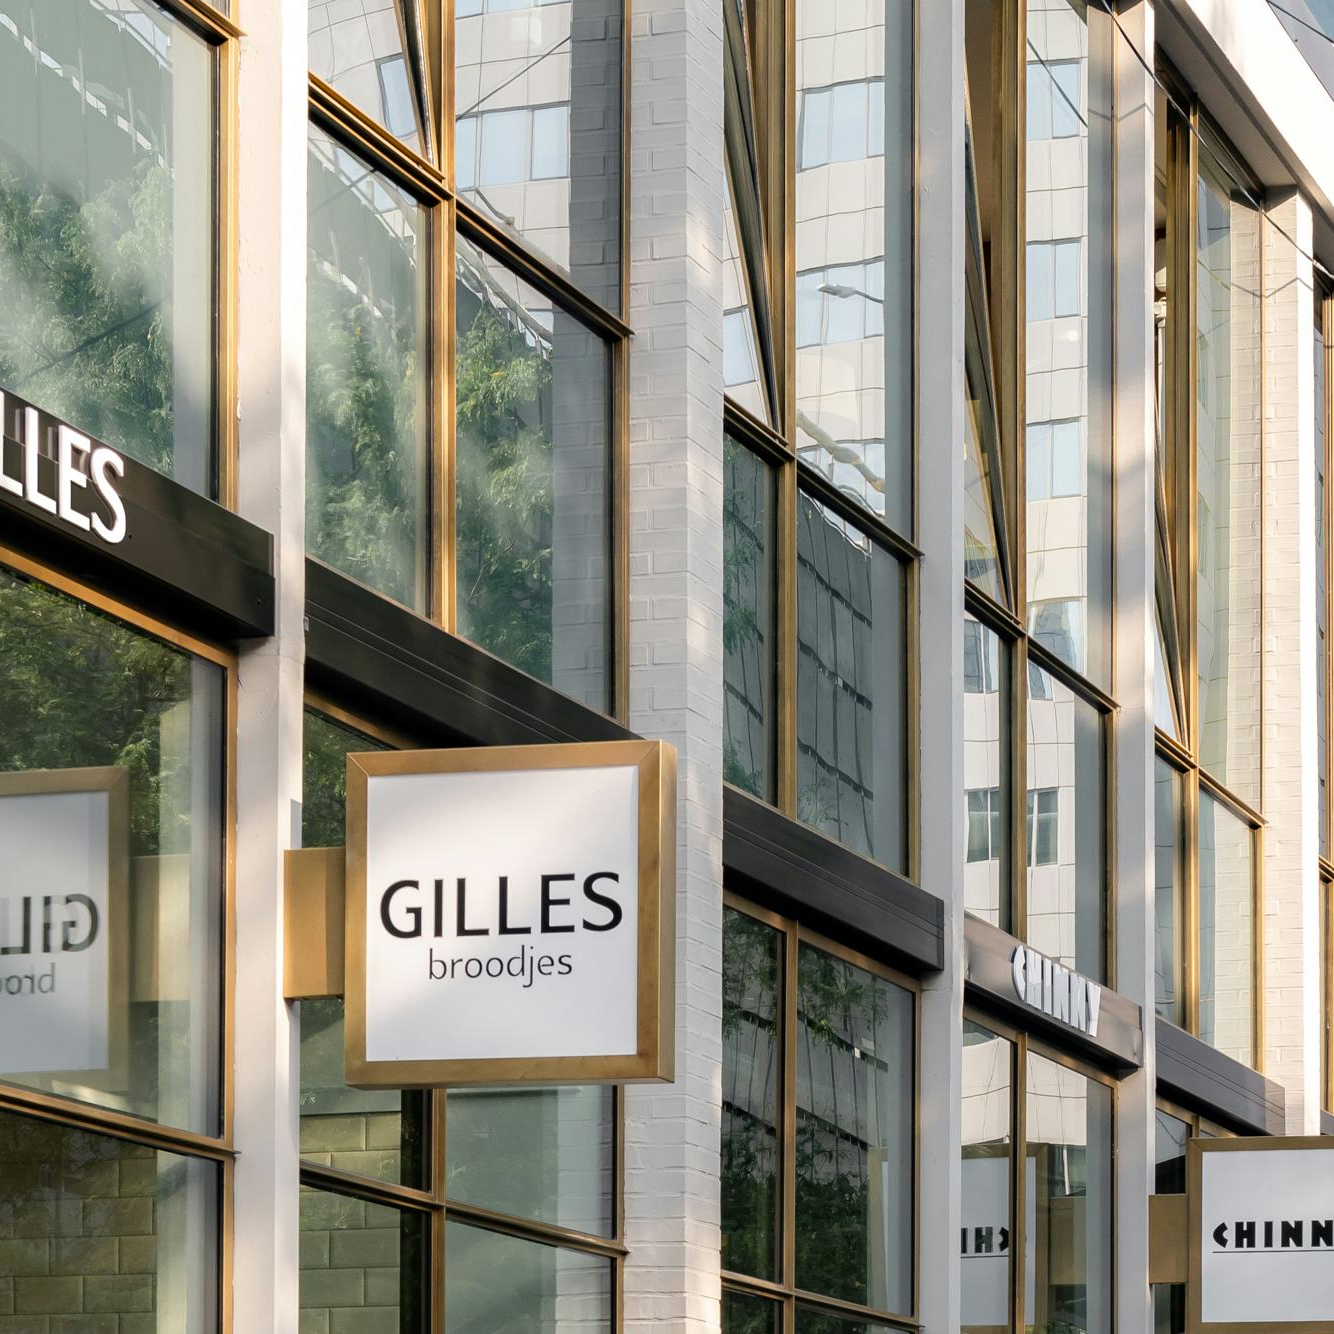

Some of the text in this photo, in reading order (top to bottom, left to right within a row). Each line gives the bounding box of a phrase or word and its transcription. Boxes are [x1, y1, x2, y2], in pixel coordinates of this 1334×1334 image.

[380, 872, 623, 939] GILLES
[429, 945, 573, 988] broodjes
[1013, 944, 1102, 1038] CHINNY
